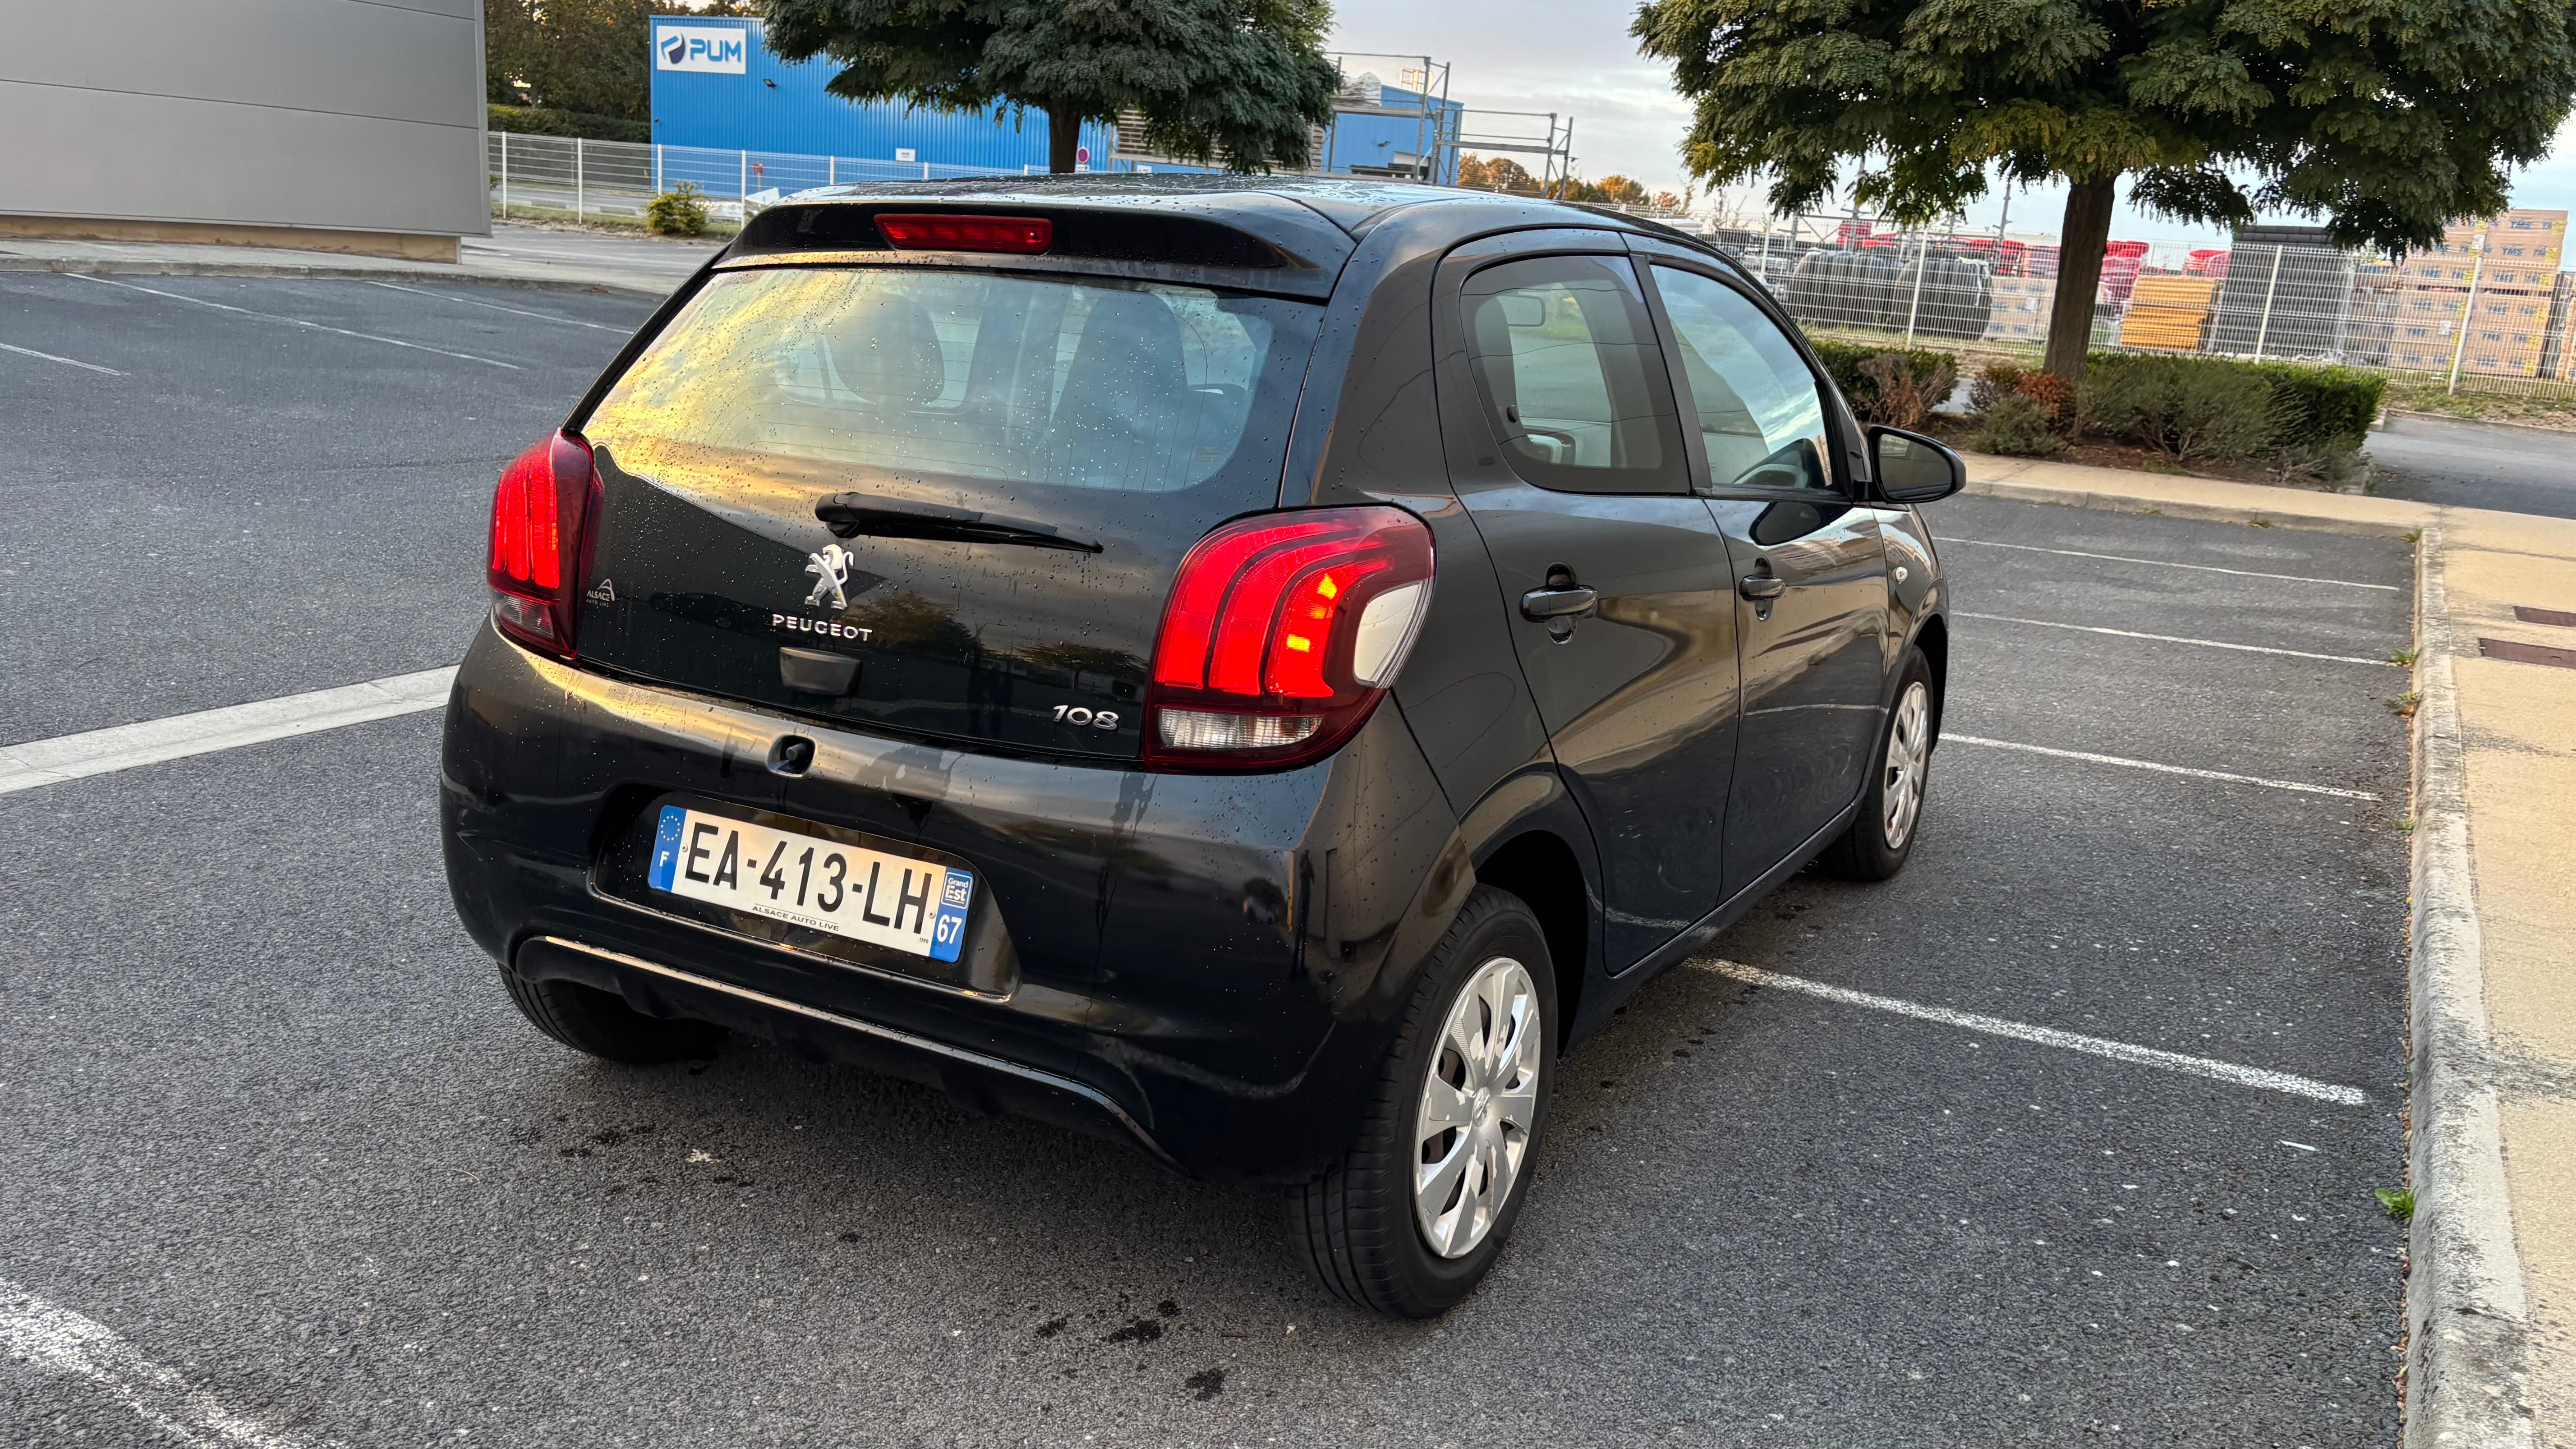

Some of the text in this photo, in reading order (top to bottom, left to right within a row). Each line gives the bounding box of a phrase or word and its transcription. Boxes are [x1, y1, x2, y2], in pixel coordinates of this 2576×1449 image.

[690, 39, 741, 62] PUM
[2502, 248, 2524, 256] TMS
[587, 590, 610, 601] ALSACE
[773, 614, 872, 641] PEUGEOT
[1053, 705, 1119, 730] 108
[659, 851, 670, 867] F
[685, 822, 932, 934] EA-413-LH
[948, 878, 969, 888] Grand
[945, 885, 966, 902] Est
[752, 906, 839, 931] ALSACE AUTO LIVE
[937, 914, 962, 944] 67
